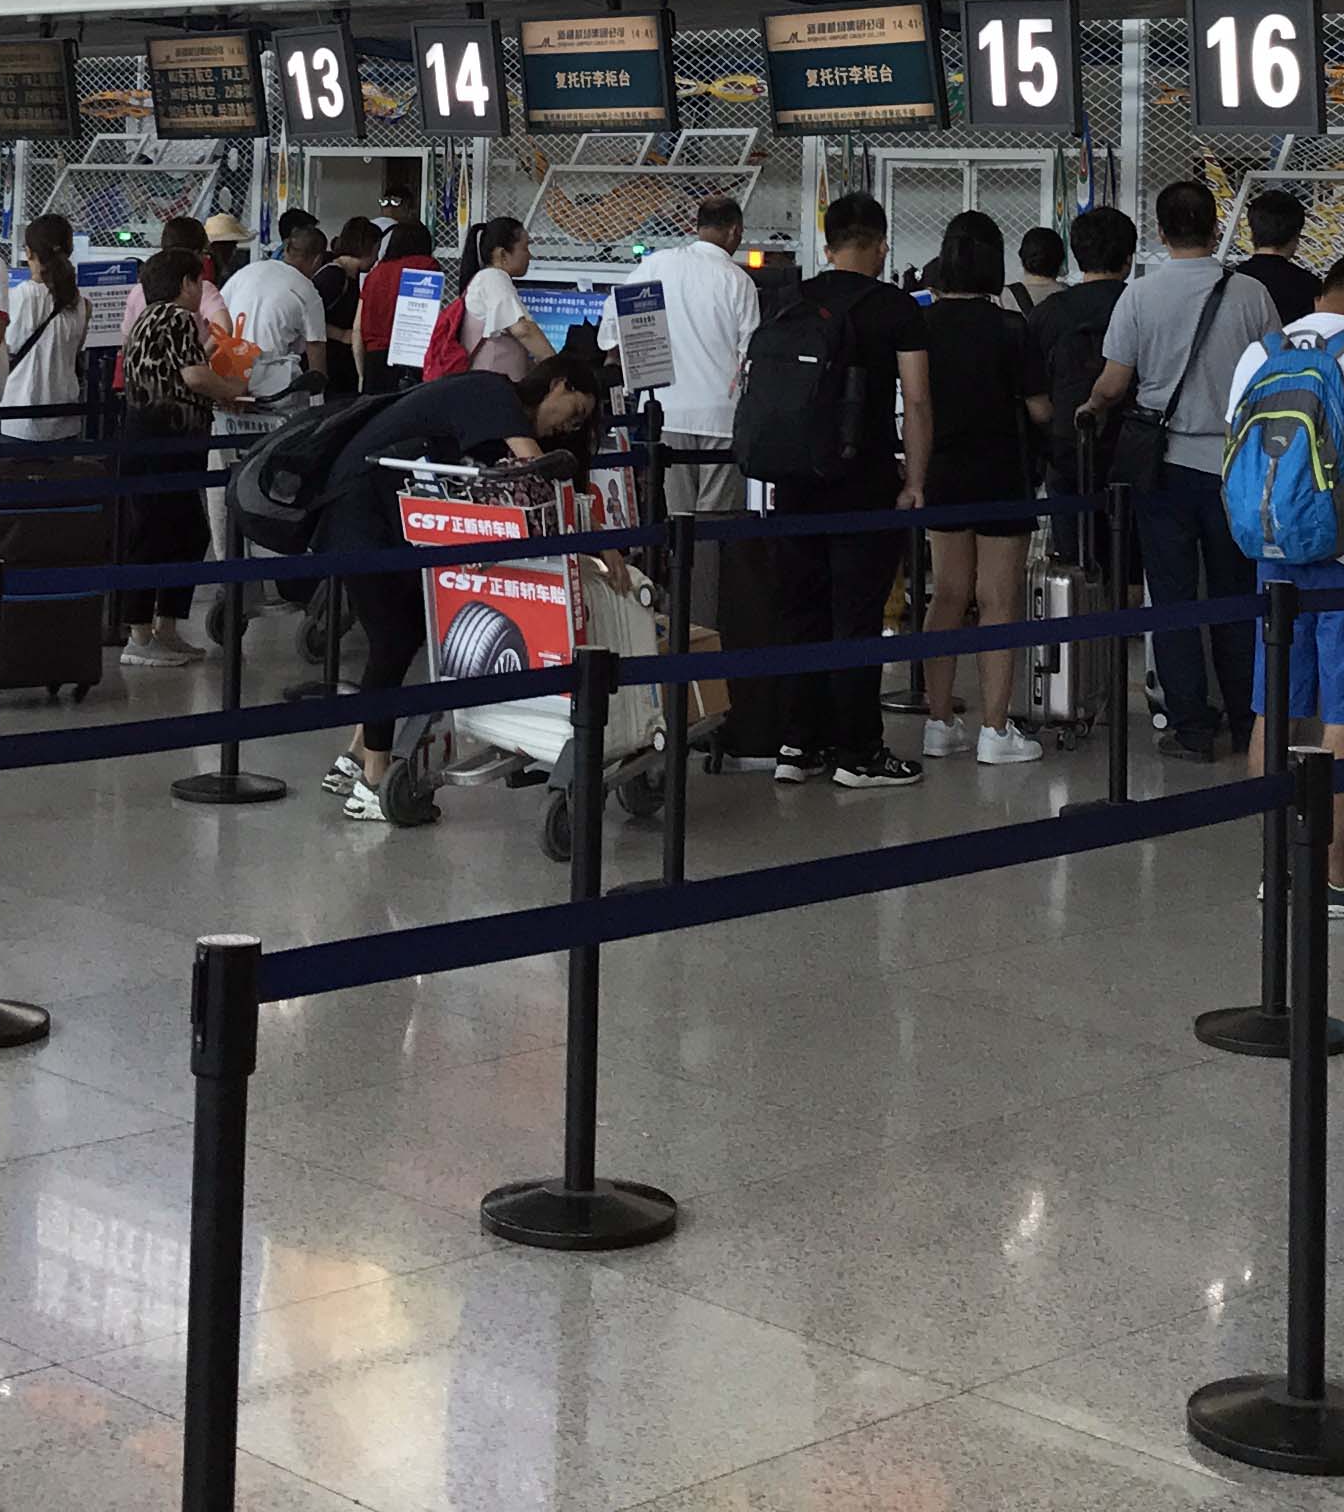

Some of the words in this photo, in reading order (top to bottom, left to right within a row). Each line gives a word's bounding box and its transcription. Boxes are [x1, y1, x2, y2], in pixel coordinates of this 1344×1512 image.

[286, 47, 345, 120] 13
[425, 41, 490, 117] 14
[555, 69, 631, 88] 复托行李柜台
[805, 64, 893, 87] 复托行李柜台
[977, 18, 1058, 108] 15
[1205, 13, 1302, 109] 16
[408, 512, 449, 531] CST
[439, 571, 487, 593] CST
[489, 576, 567, 606] 正新轿车胎
